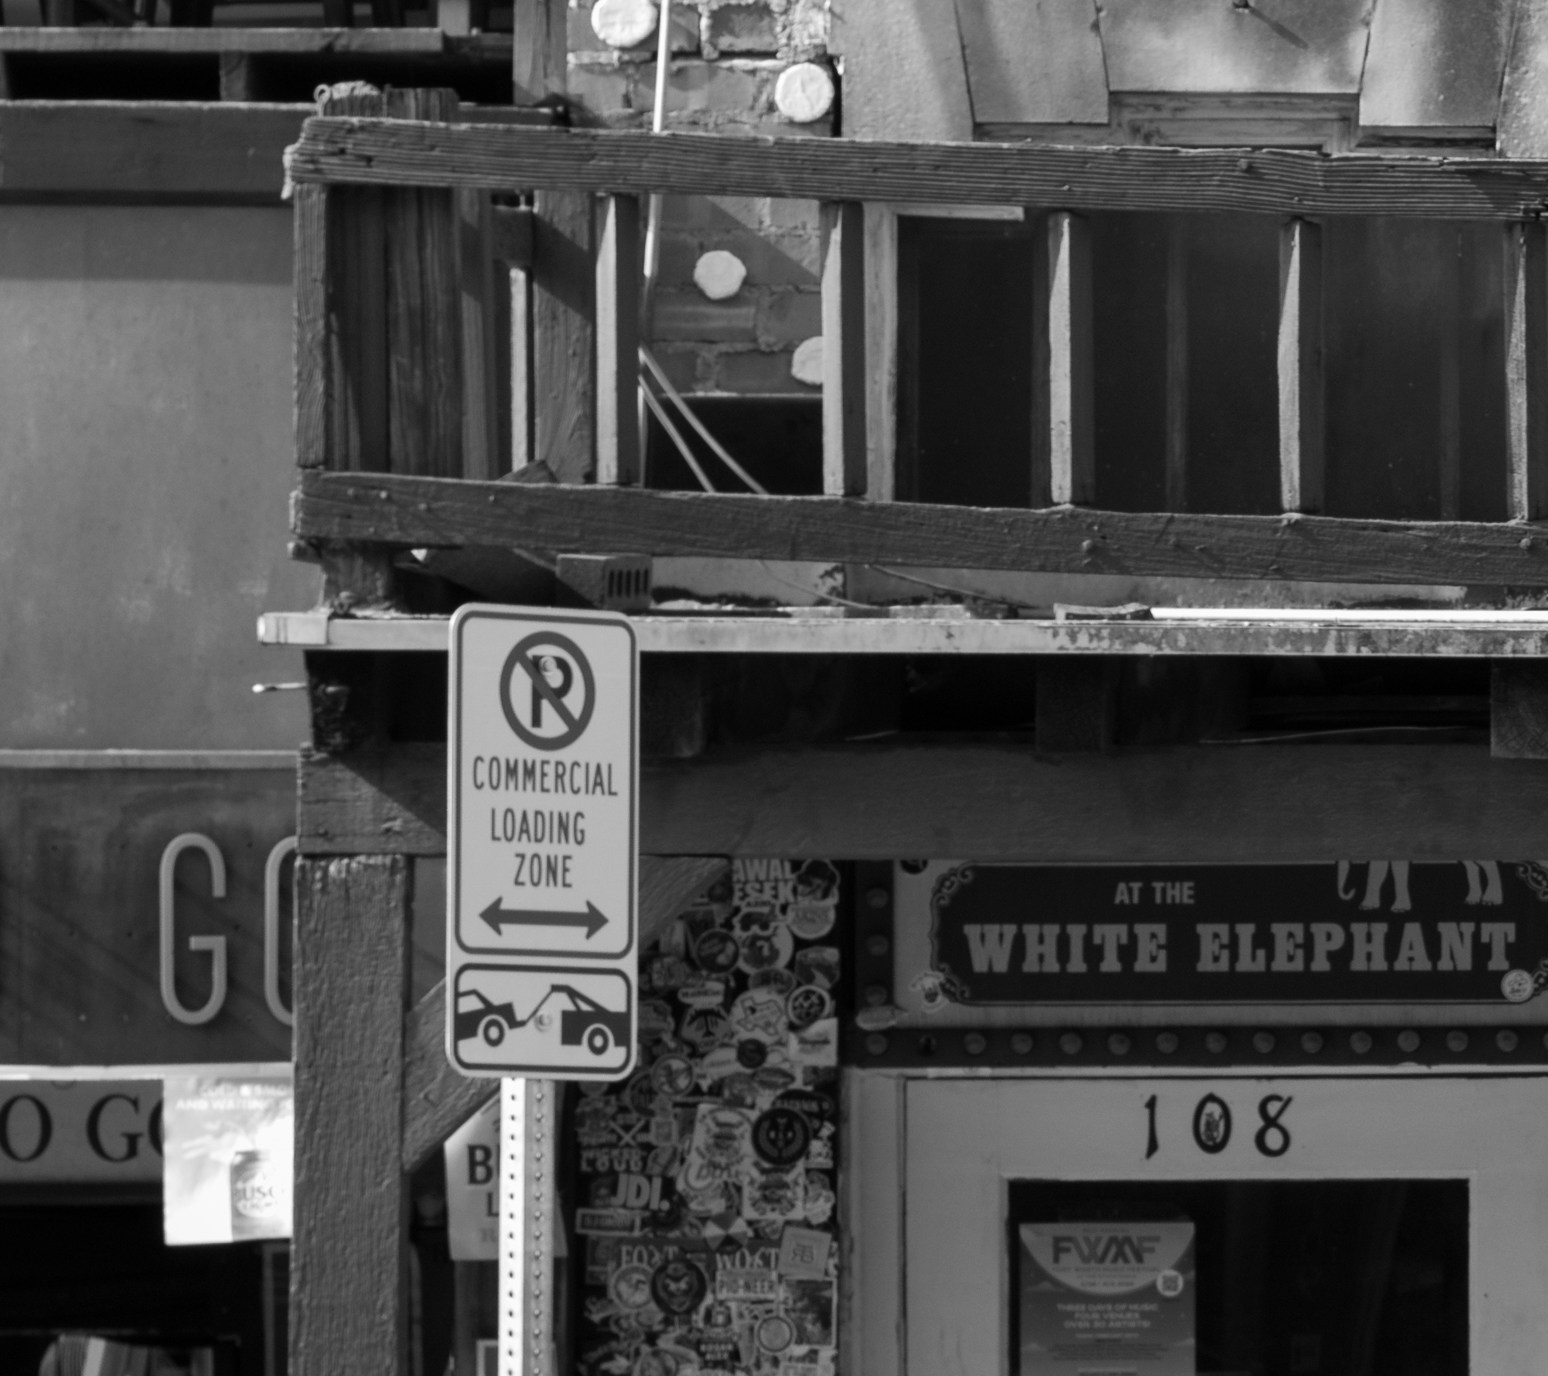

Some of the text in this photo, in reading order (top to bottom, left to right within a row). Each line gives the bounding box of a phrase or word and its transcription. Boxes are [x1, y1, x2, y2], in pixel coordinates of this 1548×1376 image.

[473, 756, 618, 796] COMMERCIAL
[491, 807, 585, 846] LOADING
[514, 853, 573, 888] ZONE
[1114, 882, 1195, 905] AT THE
[963, 923, 1516, 973] WHITE ELEPHANT
[1144, 1092, 1293, 1160] 108
